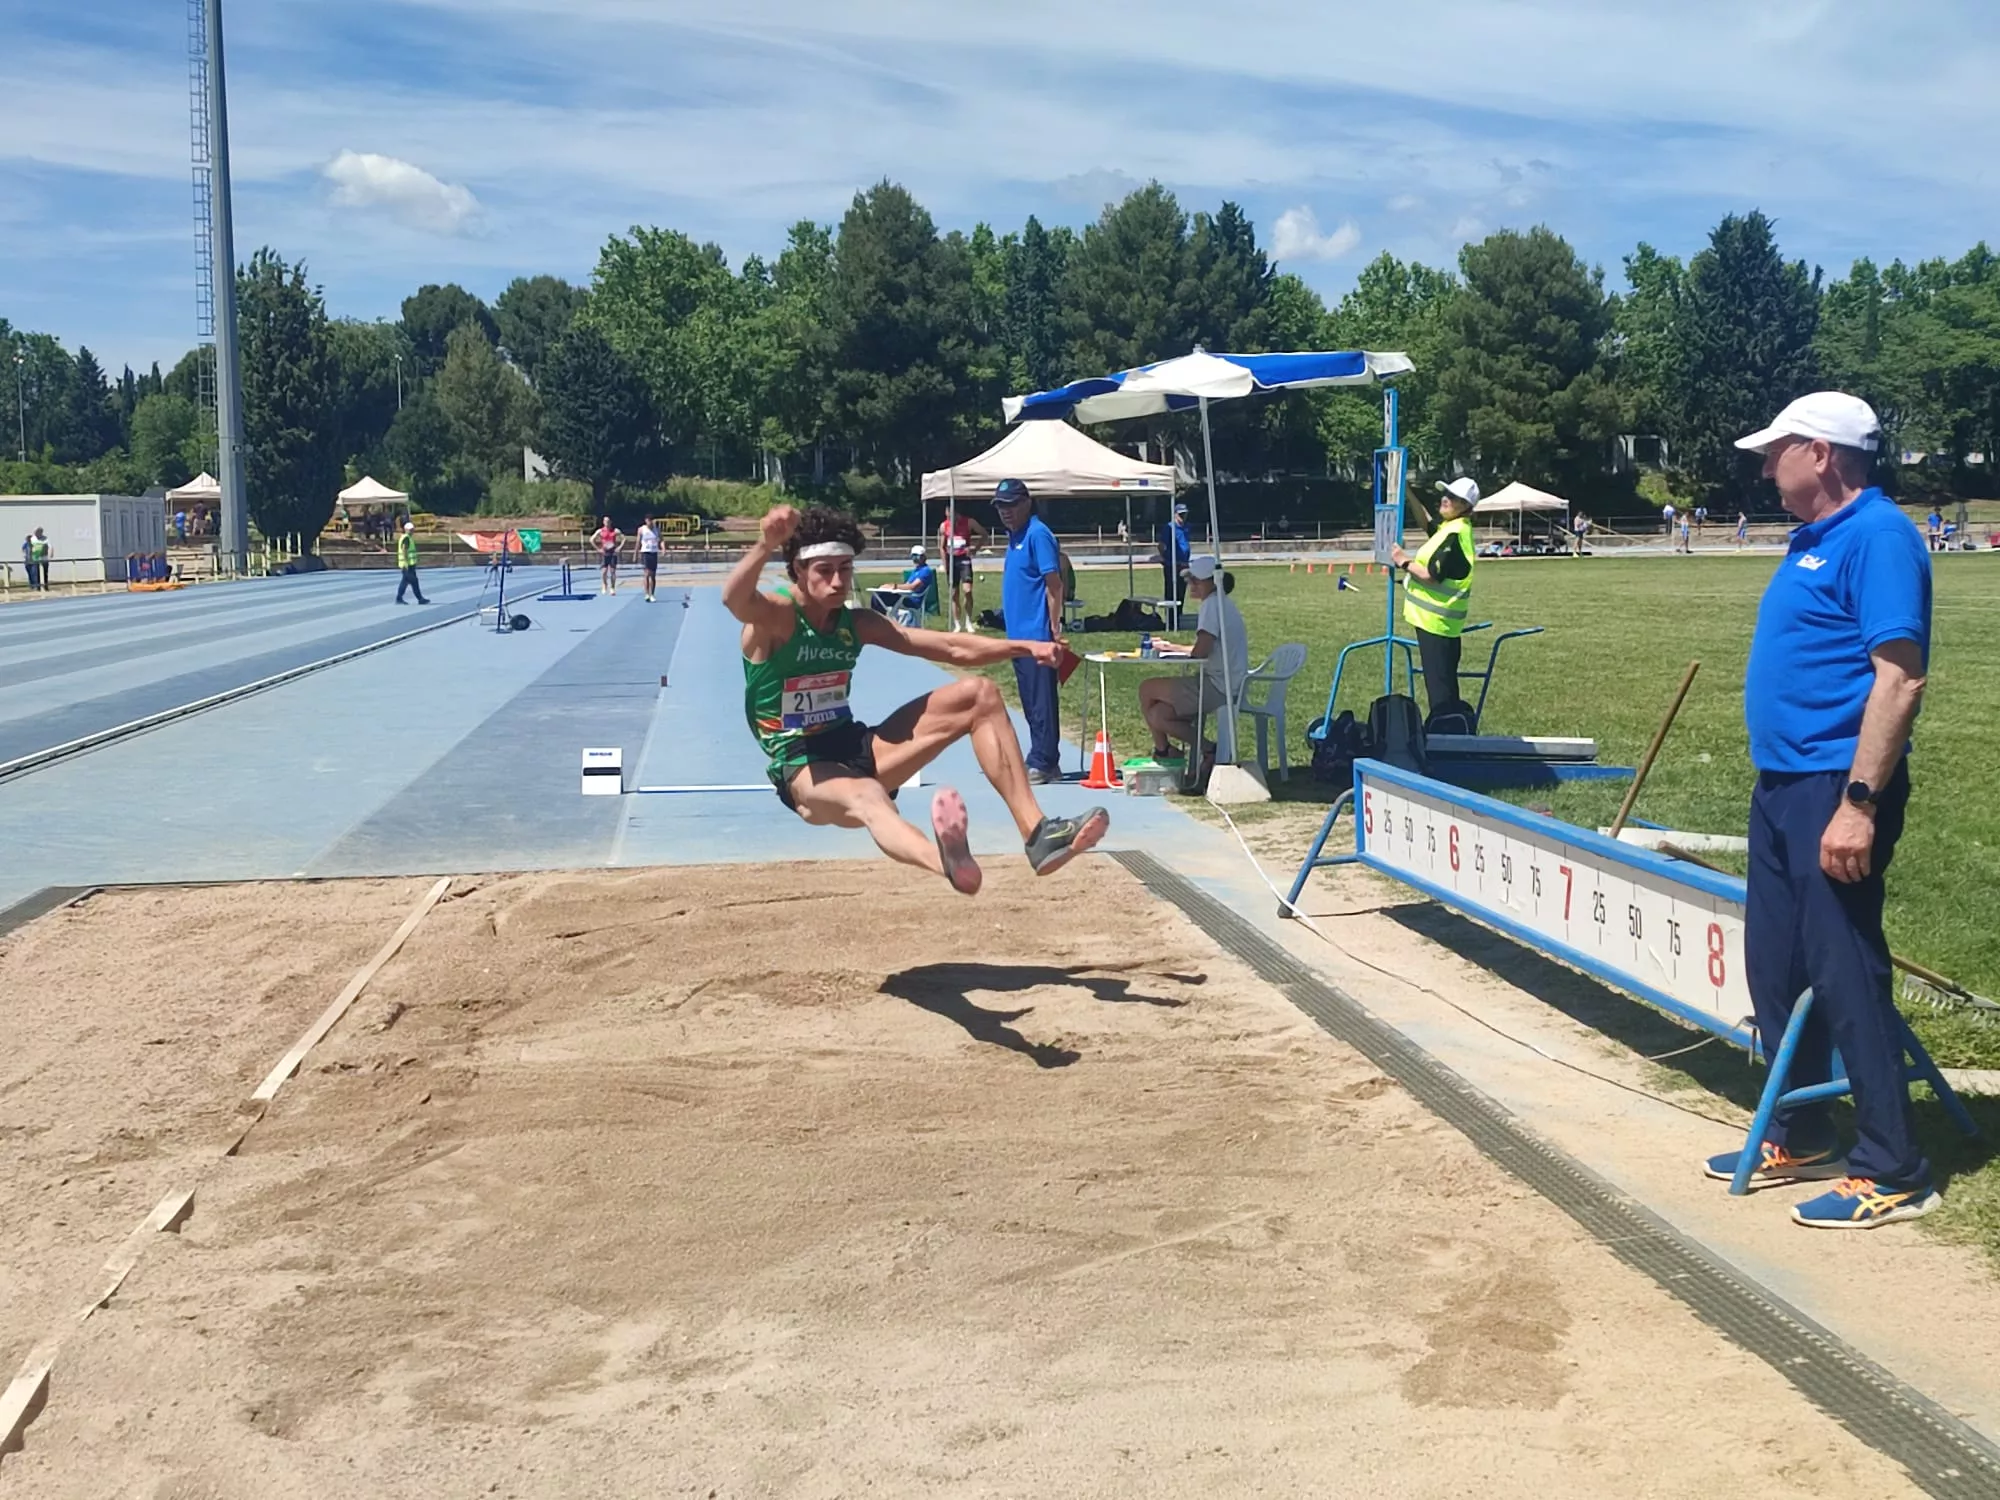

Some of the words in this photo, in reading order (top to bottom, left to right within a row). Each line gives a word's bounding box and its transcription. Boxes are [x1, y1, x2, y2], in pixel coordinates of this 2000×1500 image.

[794, 692, 813, 712] 21
[802, 711, 837, 727] Joma
[1364, 791, 1373, 834] 5
[1384, 808, 1393, 834] 25
[1404, 815, 1414, 843] 50
[1426, 824, 1436, 853] 75
[1449, 825, 1461, 871] 6
[1474, 844, 1485, 873] 25
[1501, 853, 1512, 884] 50
[1530, 865, 1541, 897] 75
[1559, 865, 1573, 921] 7
[1593, 891, 1606, 924] 25
[1629, 904, 1641, 939] 50
[1667, 919, 1681, 957] 75
[1707, 922, 1725, 987] 8
